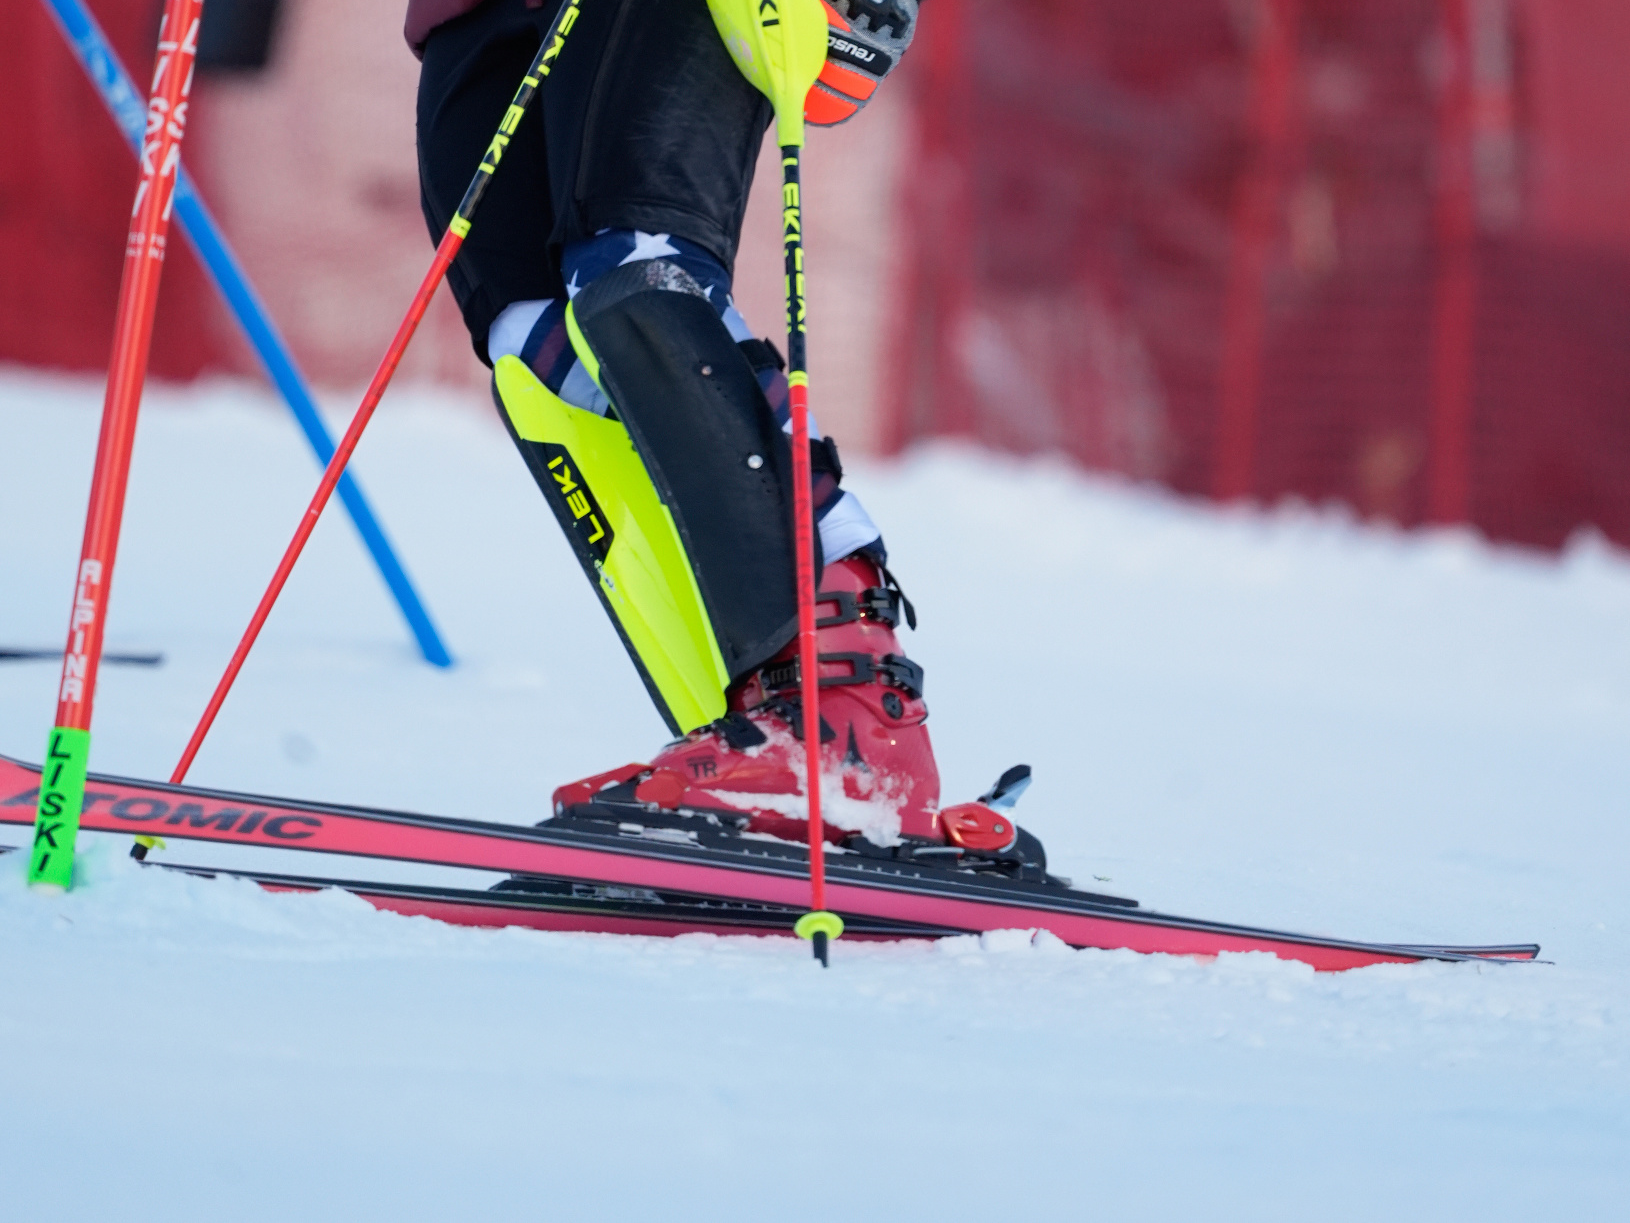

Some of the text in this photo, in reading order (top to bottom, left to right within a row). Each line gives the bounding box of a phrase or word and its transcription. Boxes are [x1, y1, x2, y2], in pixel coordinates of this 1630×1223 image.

[827, 37, 877, 63] reusc
[479, 76, 541, 176] LEKI
[782, 157, 801, 243] LEKI
[547, 455, 605, 545] LEKI
[60, 558, 102, 704] ALPINA
[35, 734, 71, 878] LISKI
[687, 760, 717, 778] TR
